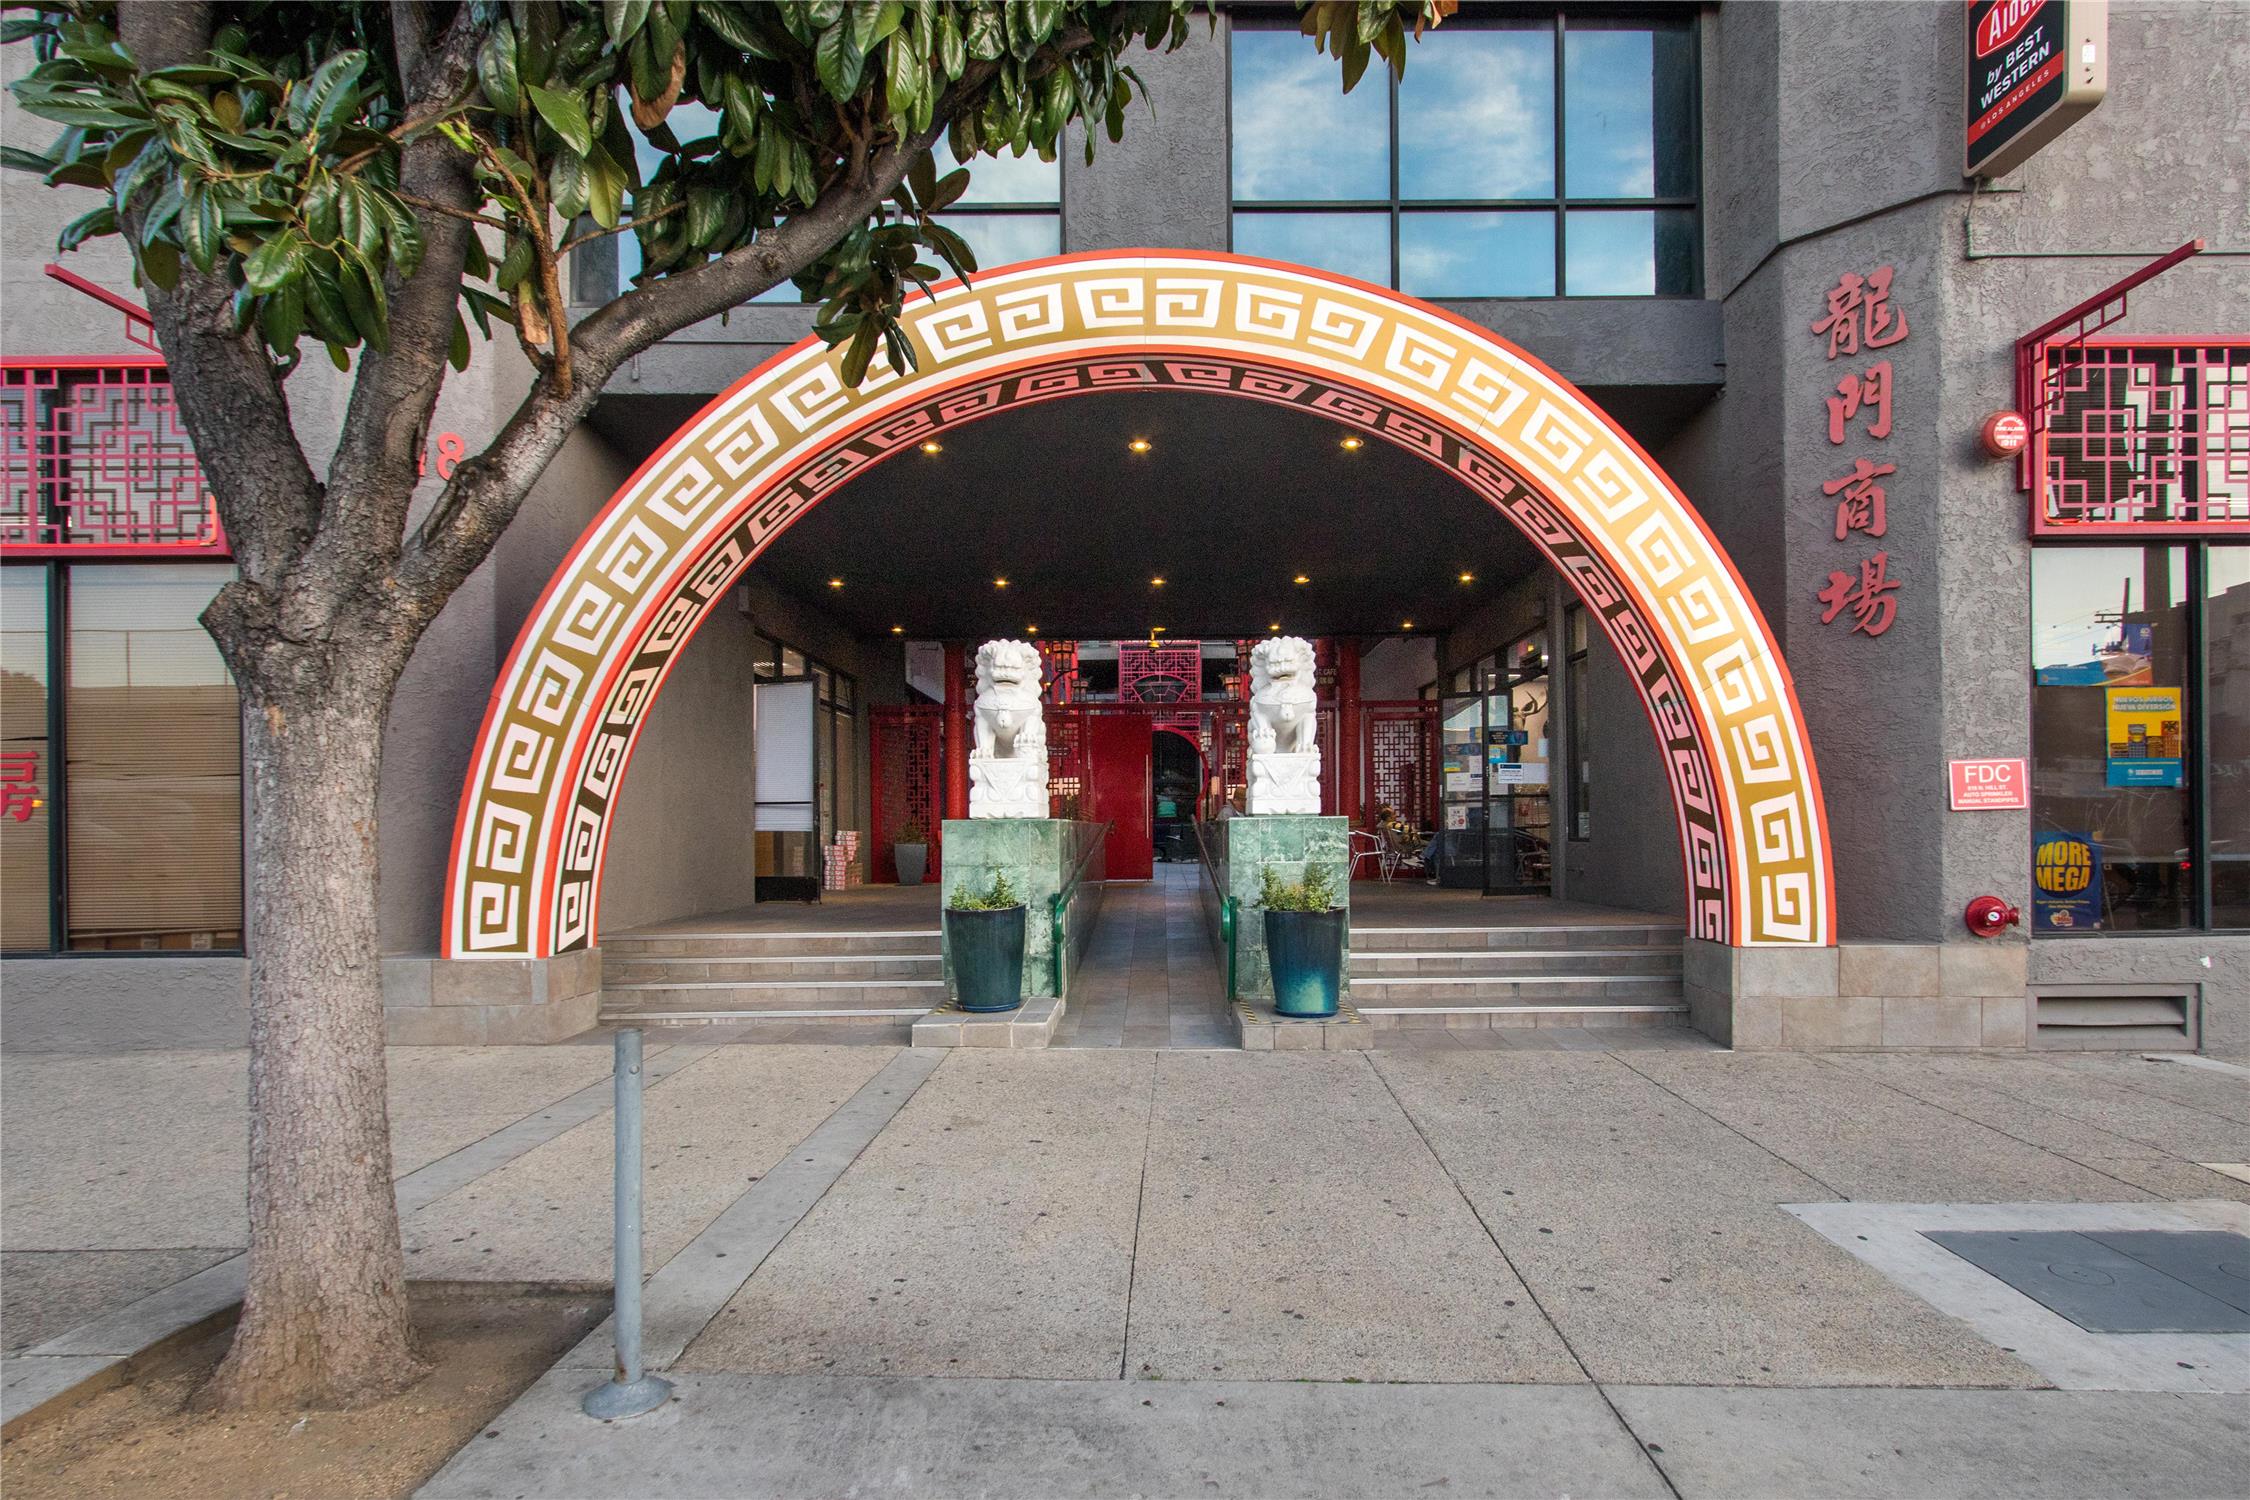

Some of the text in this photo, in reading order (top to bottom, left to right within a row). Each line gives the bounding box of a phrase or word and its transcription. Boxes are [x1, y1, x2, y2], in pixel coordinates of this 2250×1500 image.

[1988, 0, 2041, 47] Aide
[1981, 41, 2049, 109] WESTERN
[1987, 25, 2043, 87] by BEST
[2005, 69, 2049, 108] ANGELES
[1811, 265, 1908, 637] 龍門商場
[1964, 764, 2012, 784] FDC
[2036, 841, 2092, 866] MORE
[2035, 866, 2091, 892] MEGA
